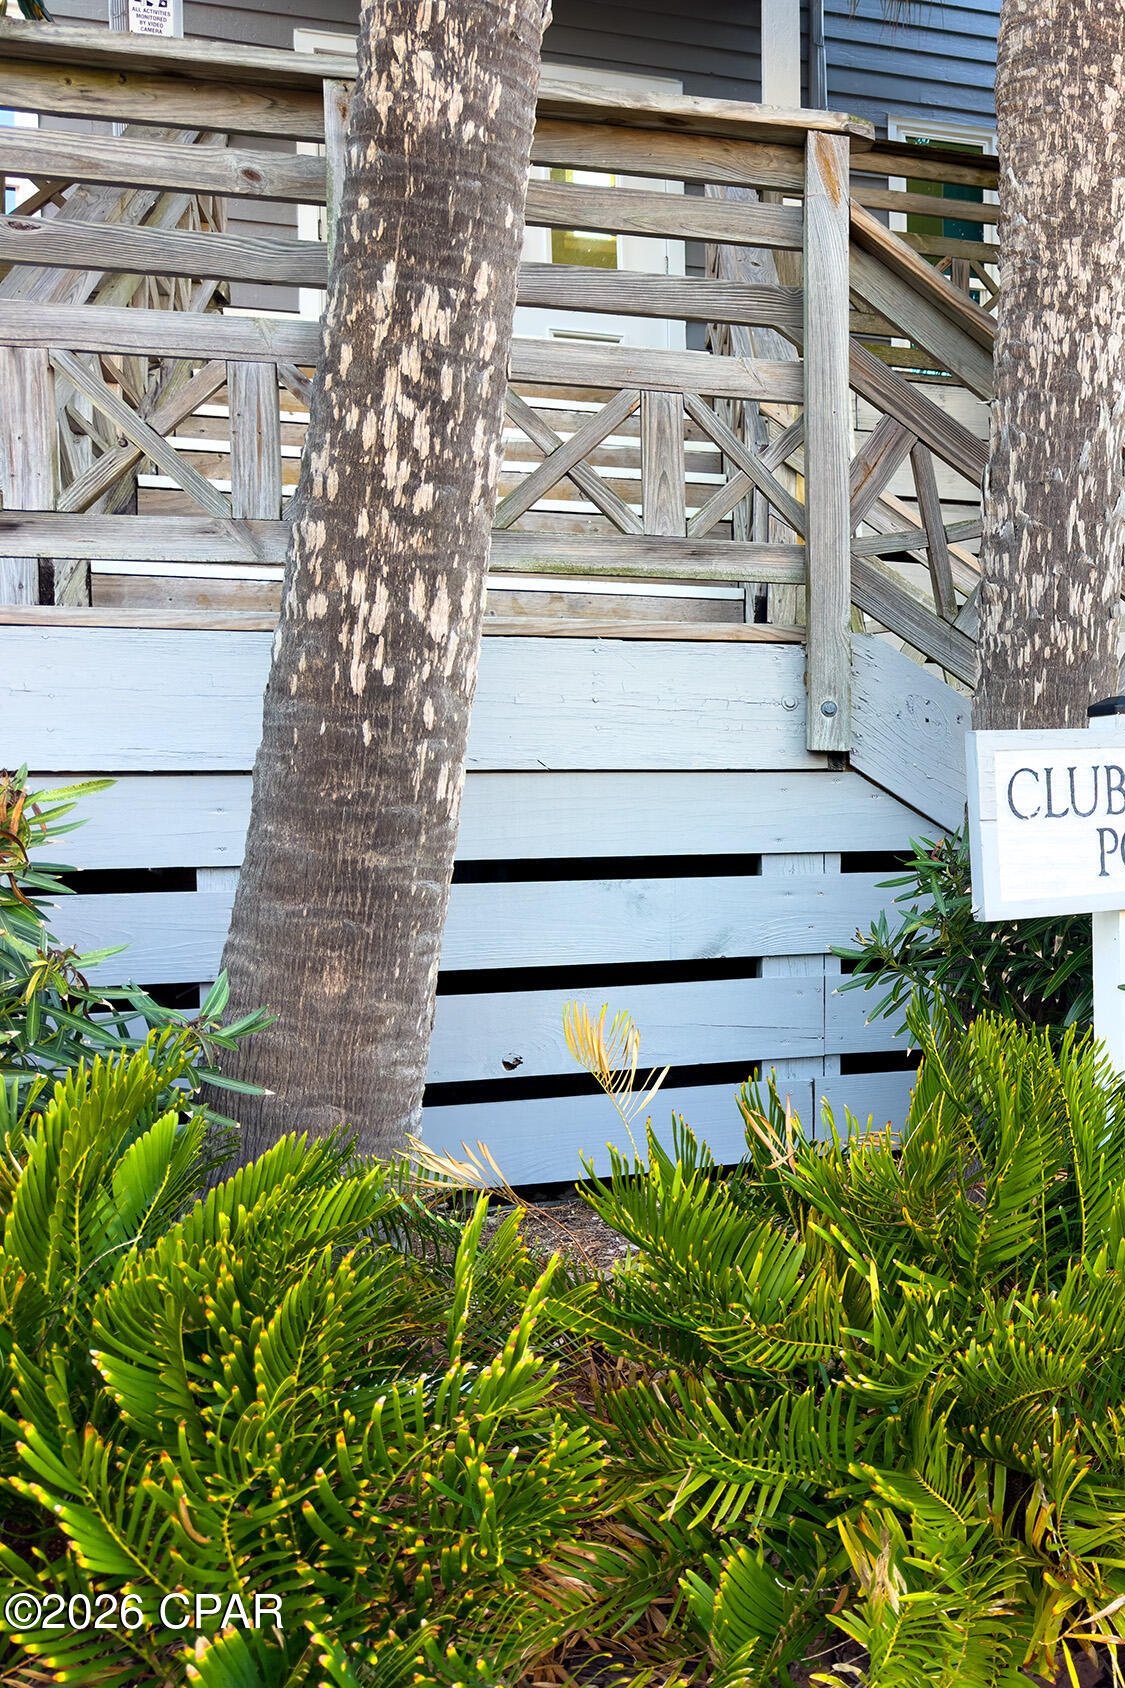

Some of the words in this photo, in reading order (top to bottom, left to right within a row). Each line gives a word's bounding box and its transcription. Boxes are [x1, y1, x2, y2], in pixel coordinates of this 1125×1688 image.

[143, 8, 171, 17] ACTIVITIES
[136, 13, 167, 22] MONITORED
[140, 26, 163, 34] CAMERA
